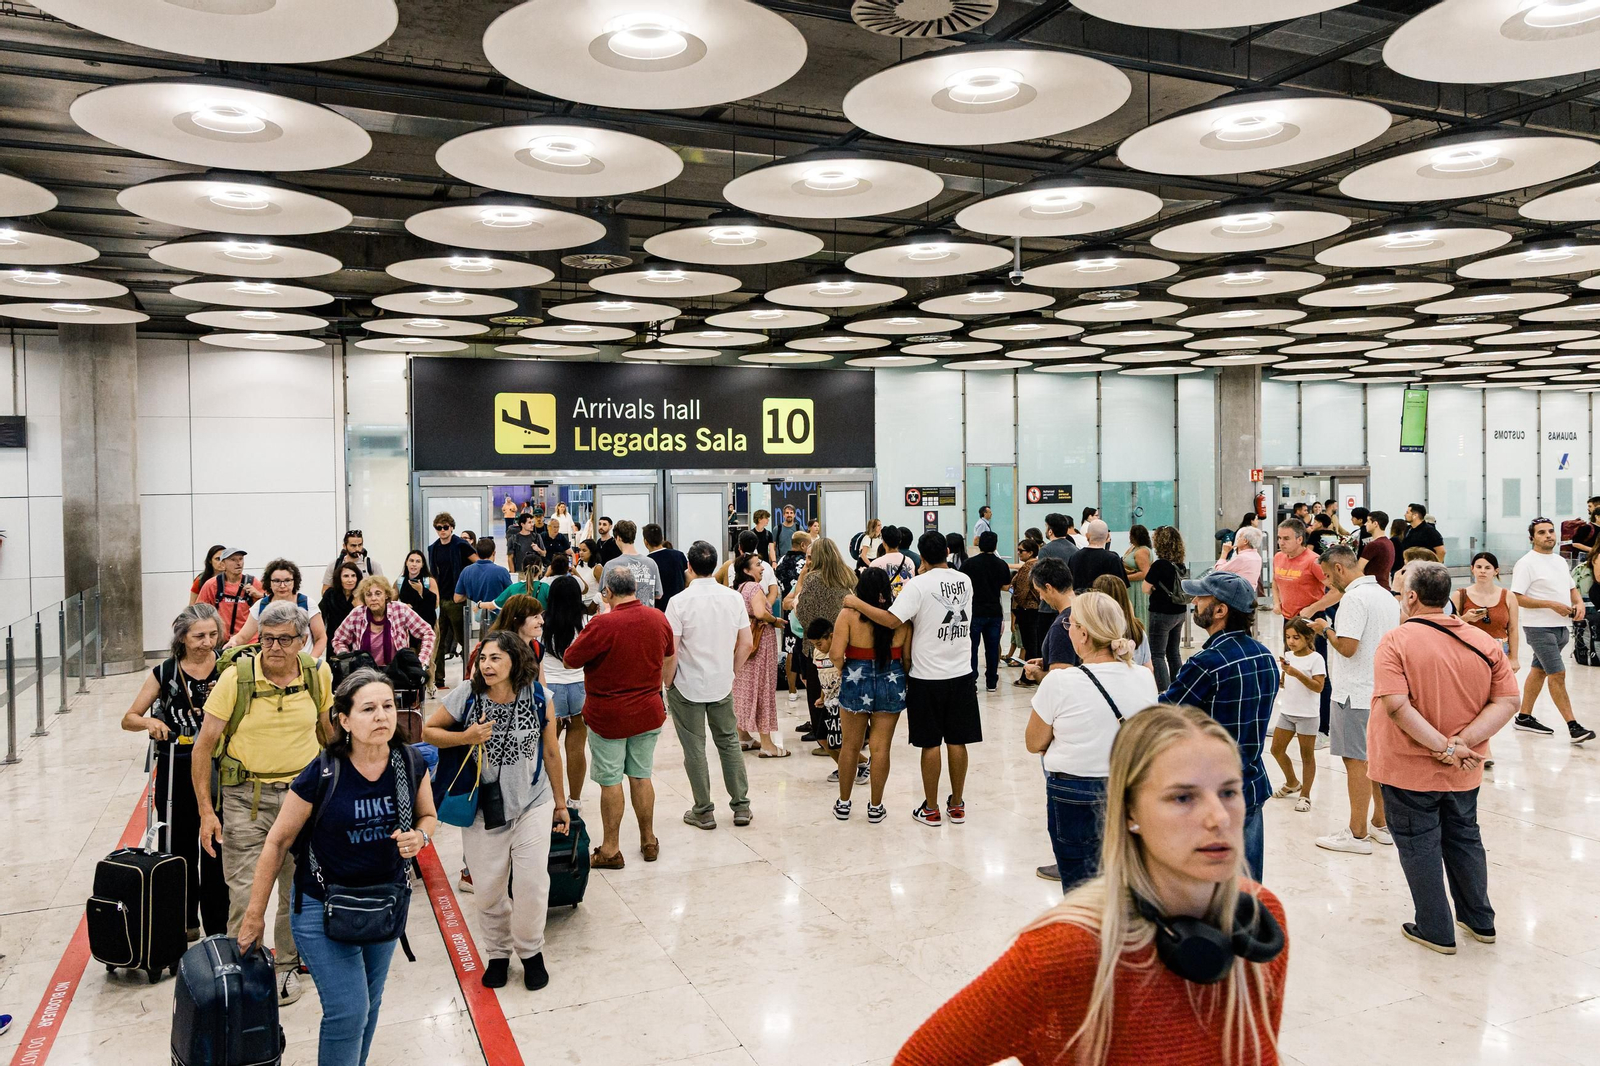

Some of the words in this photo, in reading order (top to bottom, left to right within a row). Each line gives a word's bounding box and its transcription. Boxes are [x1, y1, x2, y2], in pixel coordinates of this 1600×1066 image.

[572, 397, 655, 419] Arrivals
[663, 398, 701, 420] hall
[767, 408, 810, 444] 10
[574, 427, 687, 457] Llegadas
[695, 427, 747, 452] Sala
[354, 796, 396, 819] HIKE
[438, 895, 452, 910] BLOCK
[443, 910, 456, 920] NOT
[446, 919, 459, 928] DO
[451, 933, 473, 962] BLOQUEAR
[462, 962, 477, 972] NO
[54, 981, 71, 992] NO
[37, 991, 67, 1028] BLOQUEAR
[27, 1036, 46, 1049] DO
[19, 1048, 40, 1066] NOT
